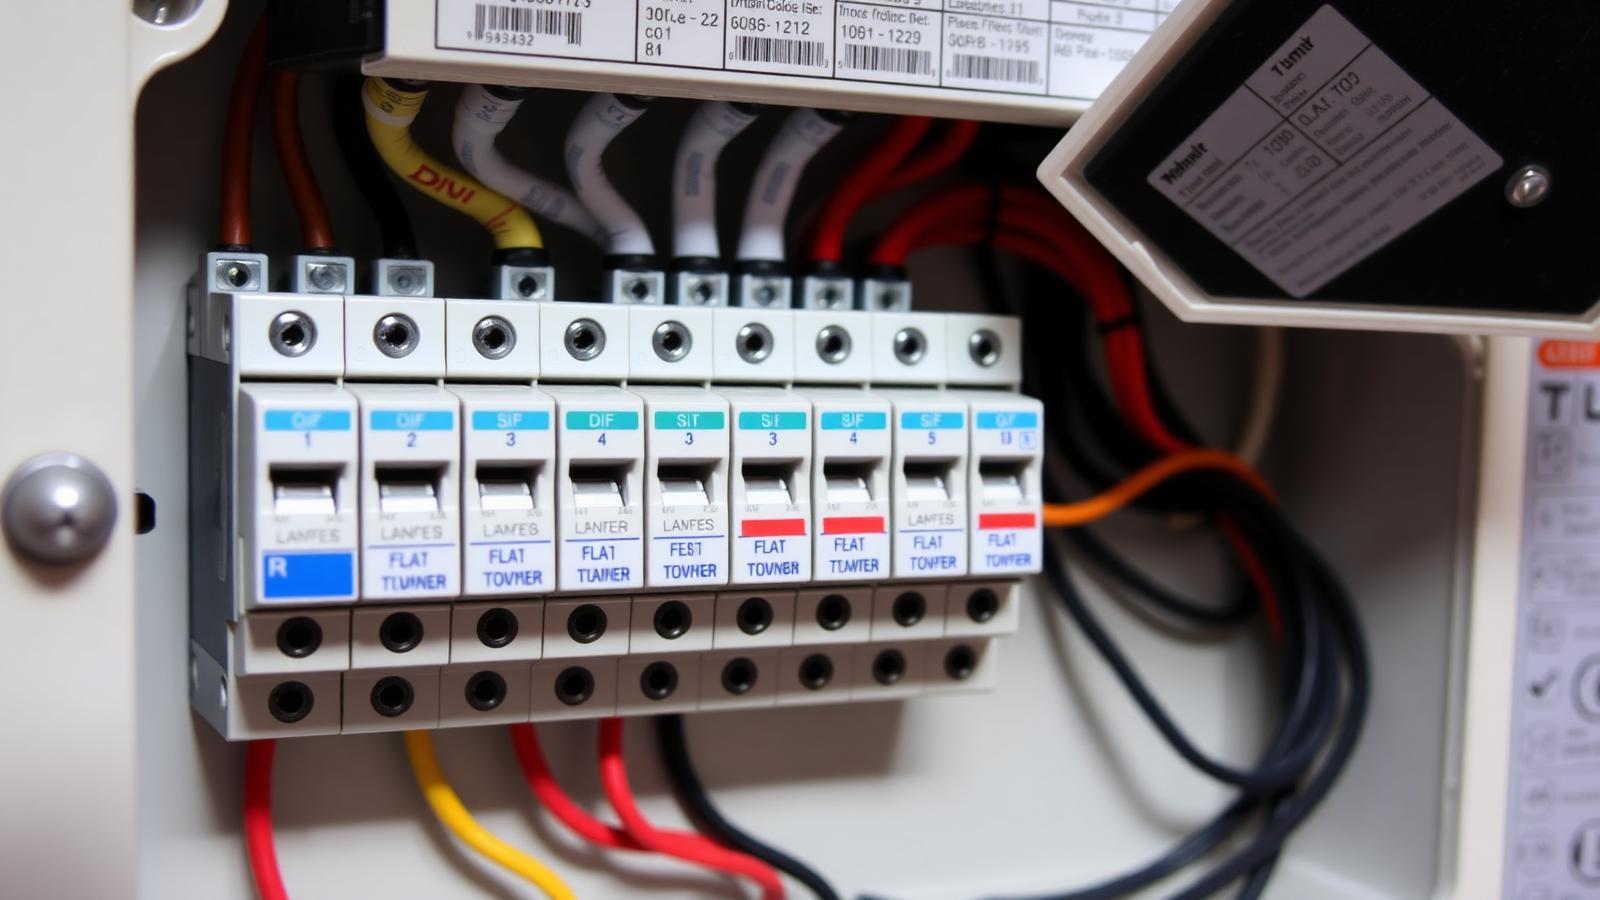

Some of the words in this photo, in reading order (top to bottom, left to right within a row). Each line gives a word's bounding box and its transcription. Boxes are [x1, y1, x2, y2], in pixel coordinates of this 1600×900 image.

[701, 12, 719, 27] 22
[407, 432, 417, 447] 2
[506, 432, 516, 447] 3
[598, 433, 606, 446] 4
[685, 432, 694, 446] 3
[769, 432, 777, 446] 3
[850, 431, 858, 445] 4
[754, 539, 786, 554] FLAT
[913, 535, 942, 550] FLAT
[988, 533, 1016, 547] FLAT
[388, 552, 428, 568] FLAT
[489, 548, 524, 564] FLAT
[582, 545, 615, 560] FLAT
[268, 557, 287, 578] R
